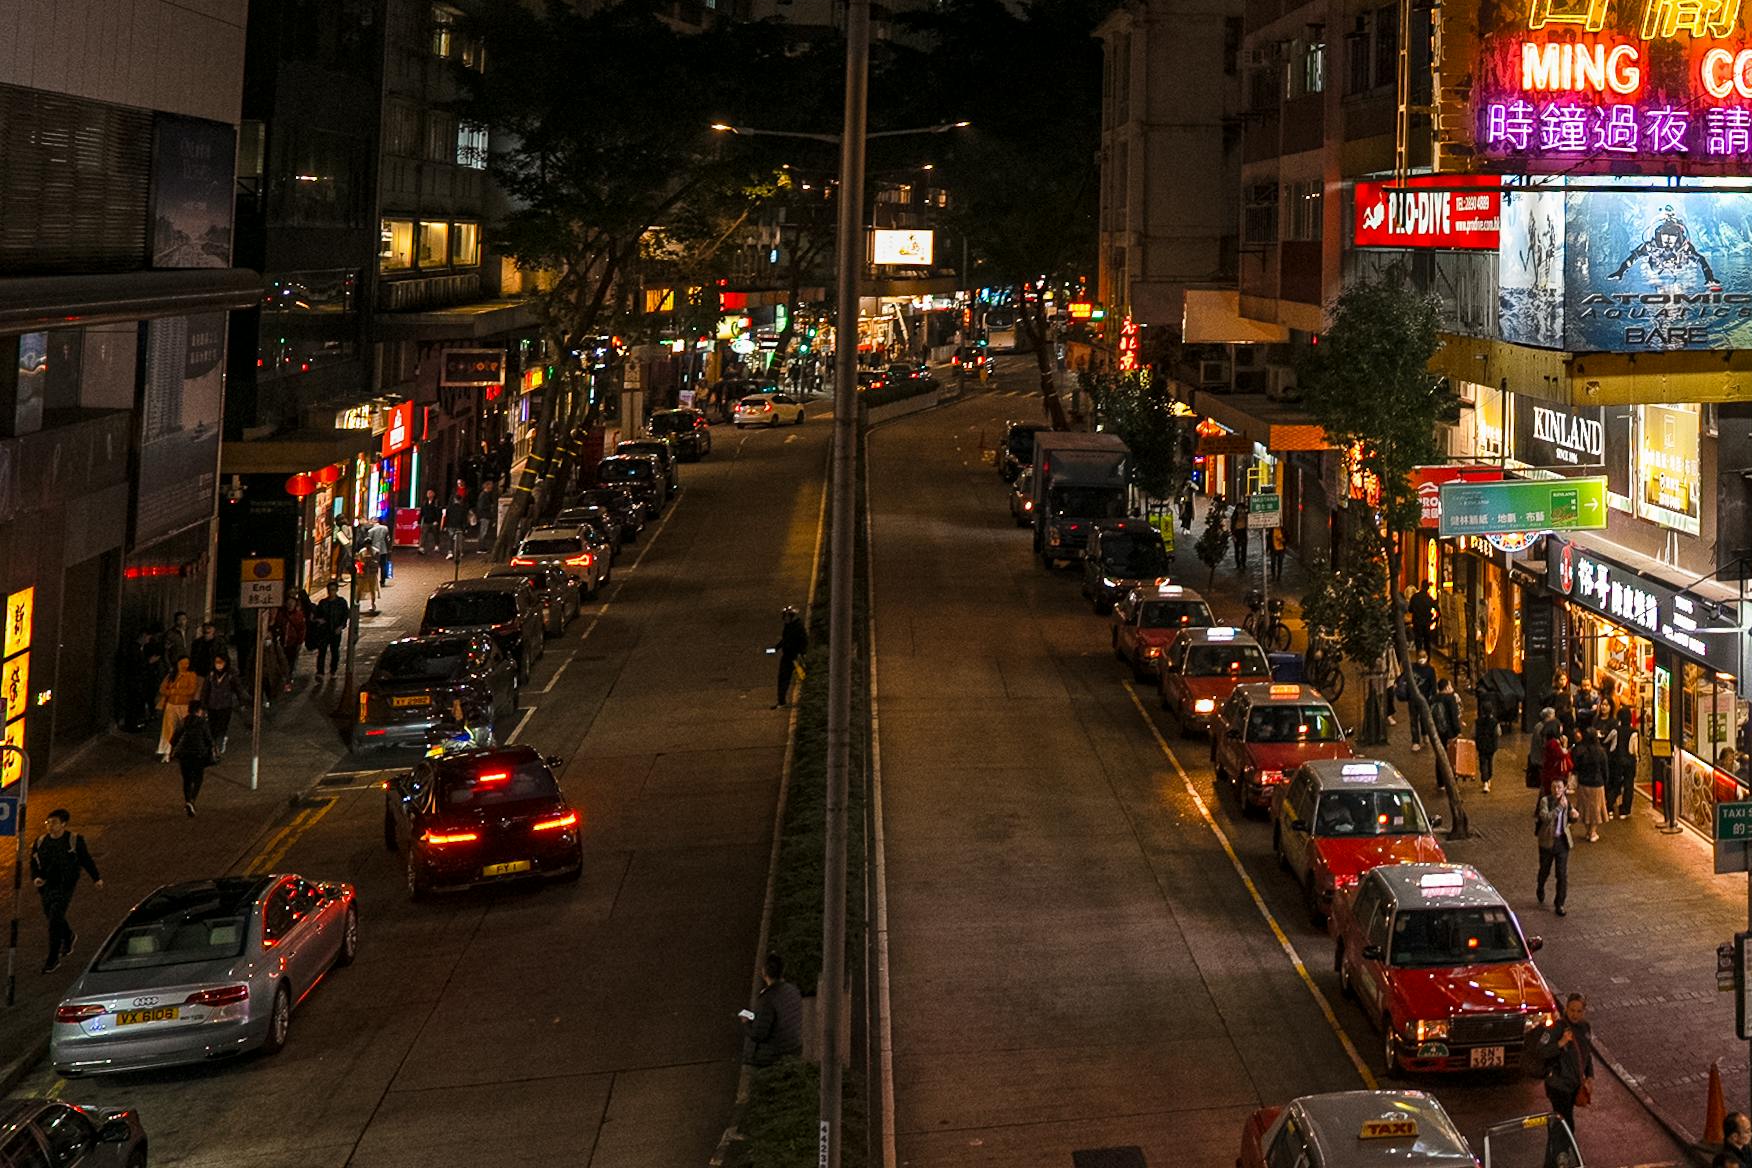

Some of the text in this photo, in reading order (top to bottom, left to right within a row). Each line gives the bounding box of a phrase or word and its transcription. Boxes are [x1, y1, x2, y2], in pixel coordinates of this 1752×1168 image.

[1521, 42, 1641, 96] MING
[1486, 103, 1691, 154] 時鐘過夜
[1580, 289, 1751, 306] ATOMIC
[1580, 307, 1752, 320] AQUATICS
[1625, 326, 1710, 345] BARE
[1533, 406, 1603, 456] KINLAND
[252, 584, 271, 593] End
[1723, 808, 1746, 818] TAXI
[121, 1009, 173, 1024] VX 6106
[1368, 1123, 1413, 1135] TAXI
